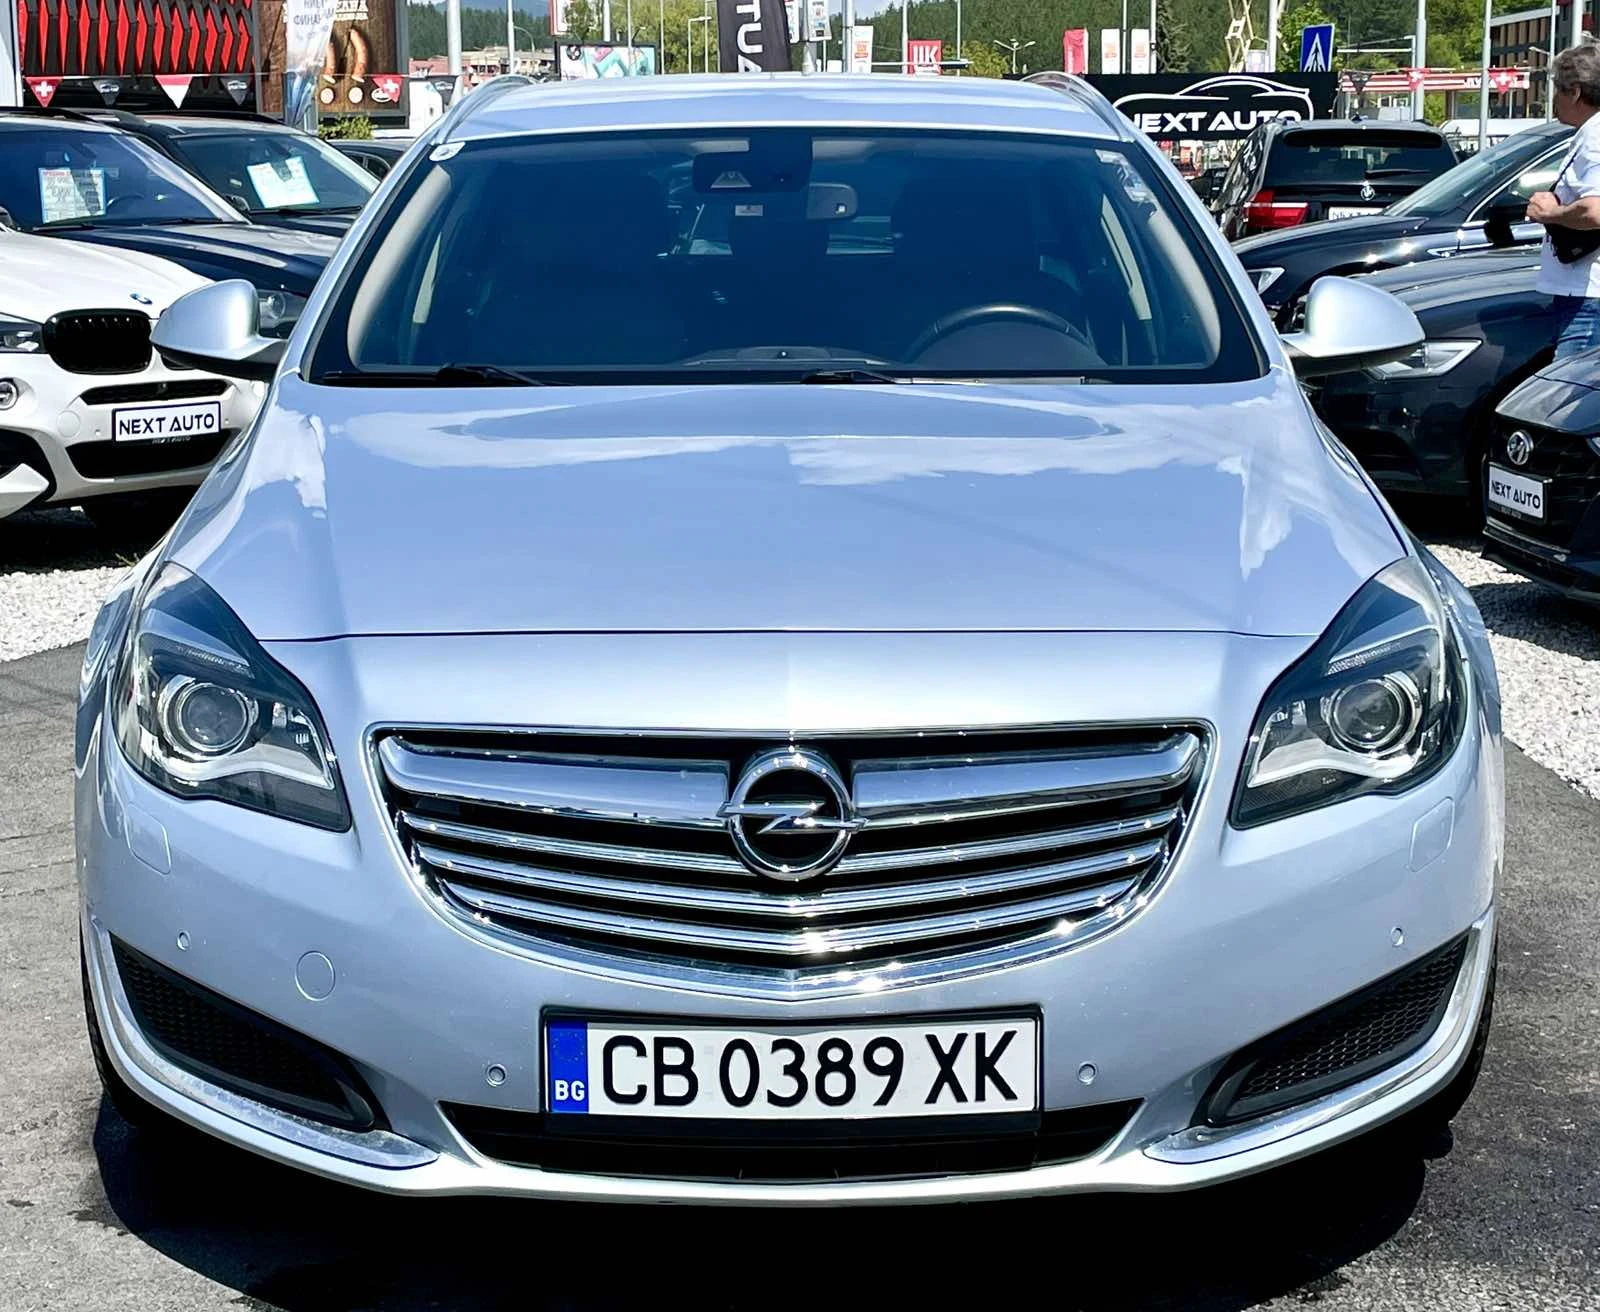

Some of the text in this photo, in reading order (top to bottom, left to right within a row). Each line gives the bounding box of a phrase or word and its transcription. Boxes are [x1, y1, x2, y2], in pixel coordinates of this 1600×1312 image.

[119, 413, 215, 435] NEXT AUTO
[1491, 480, 1541, 509] NEXT AUTO
[602, 1030, 1018, 1107] CB 0389 XK
[554, 1079, 585, 1101] BG
